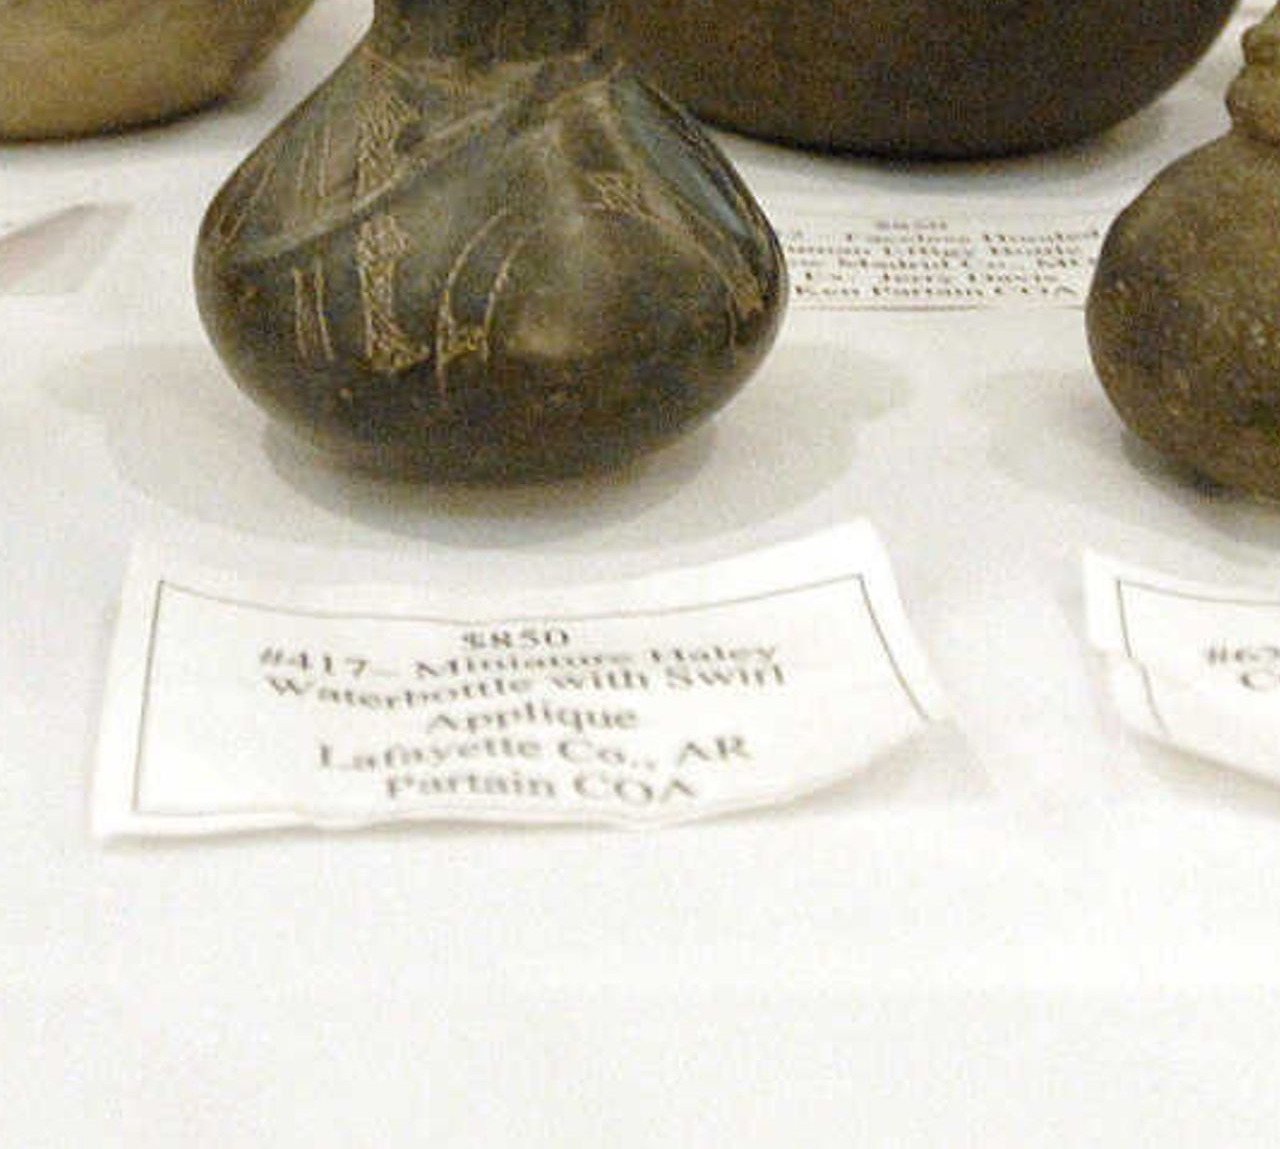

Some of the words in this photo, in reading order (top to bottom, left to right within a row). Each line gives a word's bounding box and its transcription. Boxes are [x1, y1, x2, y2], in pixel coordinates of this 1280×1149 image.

[462, 628, 570, 650] $850
[412, 652, 638, 680] Miniature
[649, 644, 776, 666] Haley
[263, 674, 534, 710] Waterbottle
[550, 666, 650, 691] with
[663, 663, 785, 689] Swirl
[425, 699, 638, 734] Applique
[317, 737, 544, 770] Lafayette
[557, 737, 657, 772] Co.,
[675, 733, 754, 767] AR
[384, 769, 557, 800] Partain
[571, 771, 700, 805] COA
